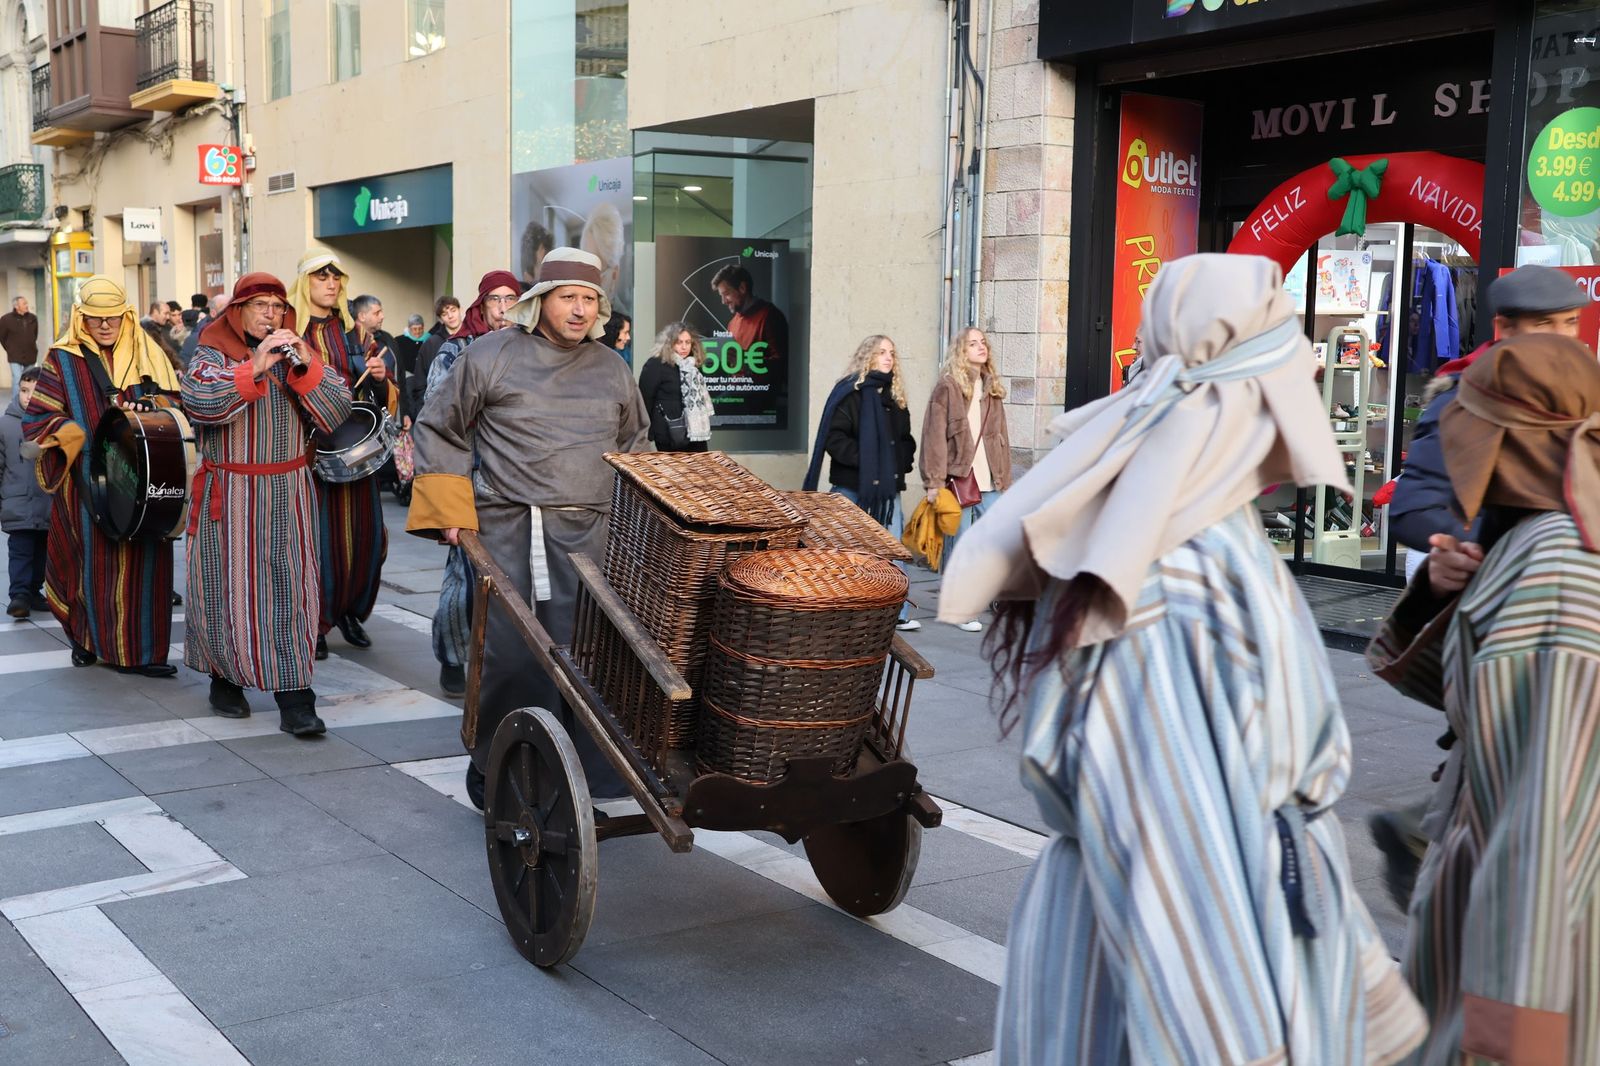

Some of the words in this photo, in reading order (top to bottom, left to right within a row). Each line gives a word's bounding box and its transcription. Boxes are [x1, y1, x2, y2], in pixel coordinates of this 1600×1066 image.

[1251, 93, 1397, 140] MOVIL
[1150, 185, 1172, 195] MODA
[1173, 187, 1196, 197] TEXTIL
[370, 194, 409, 225] Unicaja
[1250, 186, 1307, 241] FELIZ
[130, 221, 155, 230] Lowi
[754, 249, 779, 260] Unicaja
[713, 330, 733, 338] Hasta
[728, 375, 754, 384] nómina,
